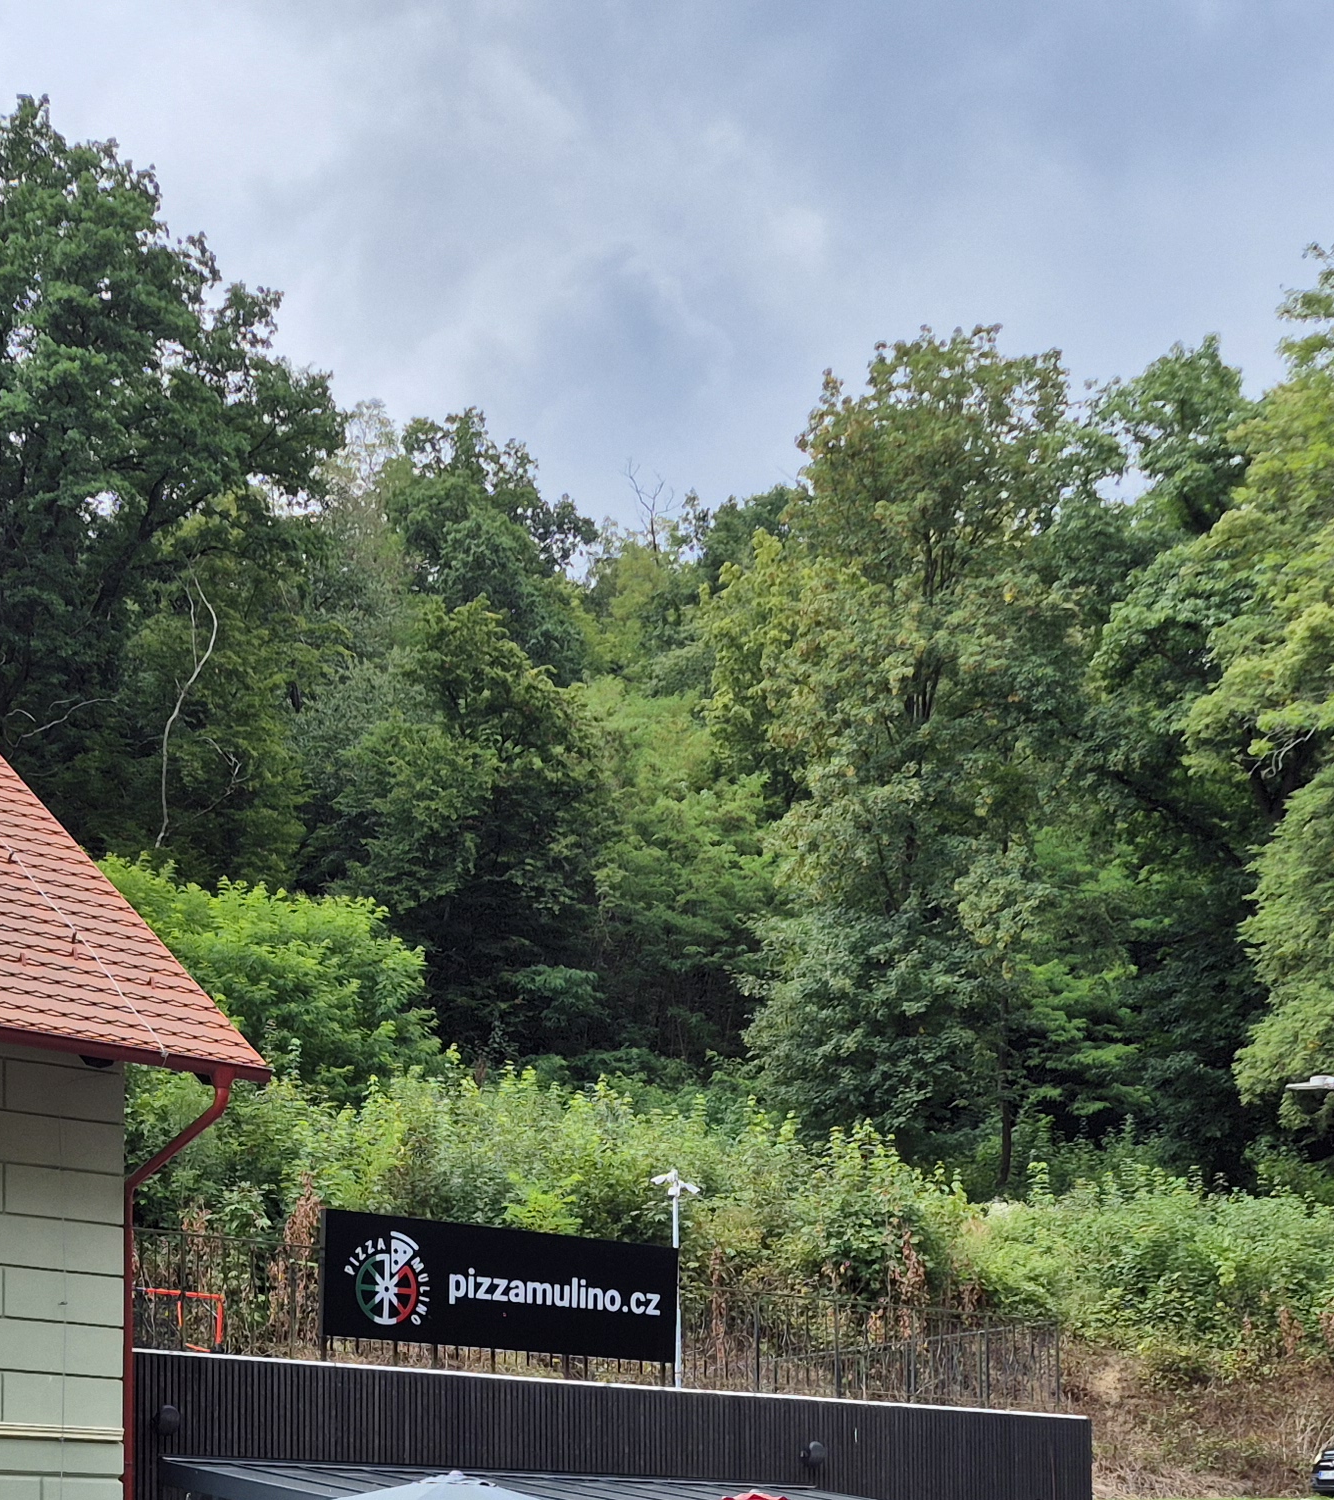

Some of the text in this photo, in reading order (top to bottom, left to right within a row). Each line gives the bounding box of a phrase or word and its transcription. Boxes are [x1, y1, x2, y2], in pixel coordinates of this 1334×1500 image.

[344, 1237, 431, 1325] PIZZA MULINO
[449, 1267, 661, 1316] pizzamulino.cz
